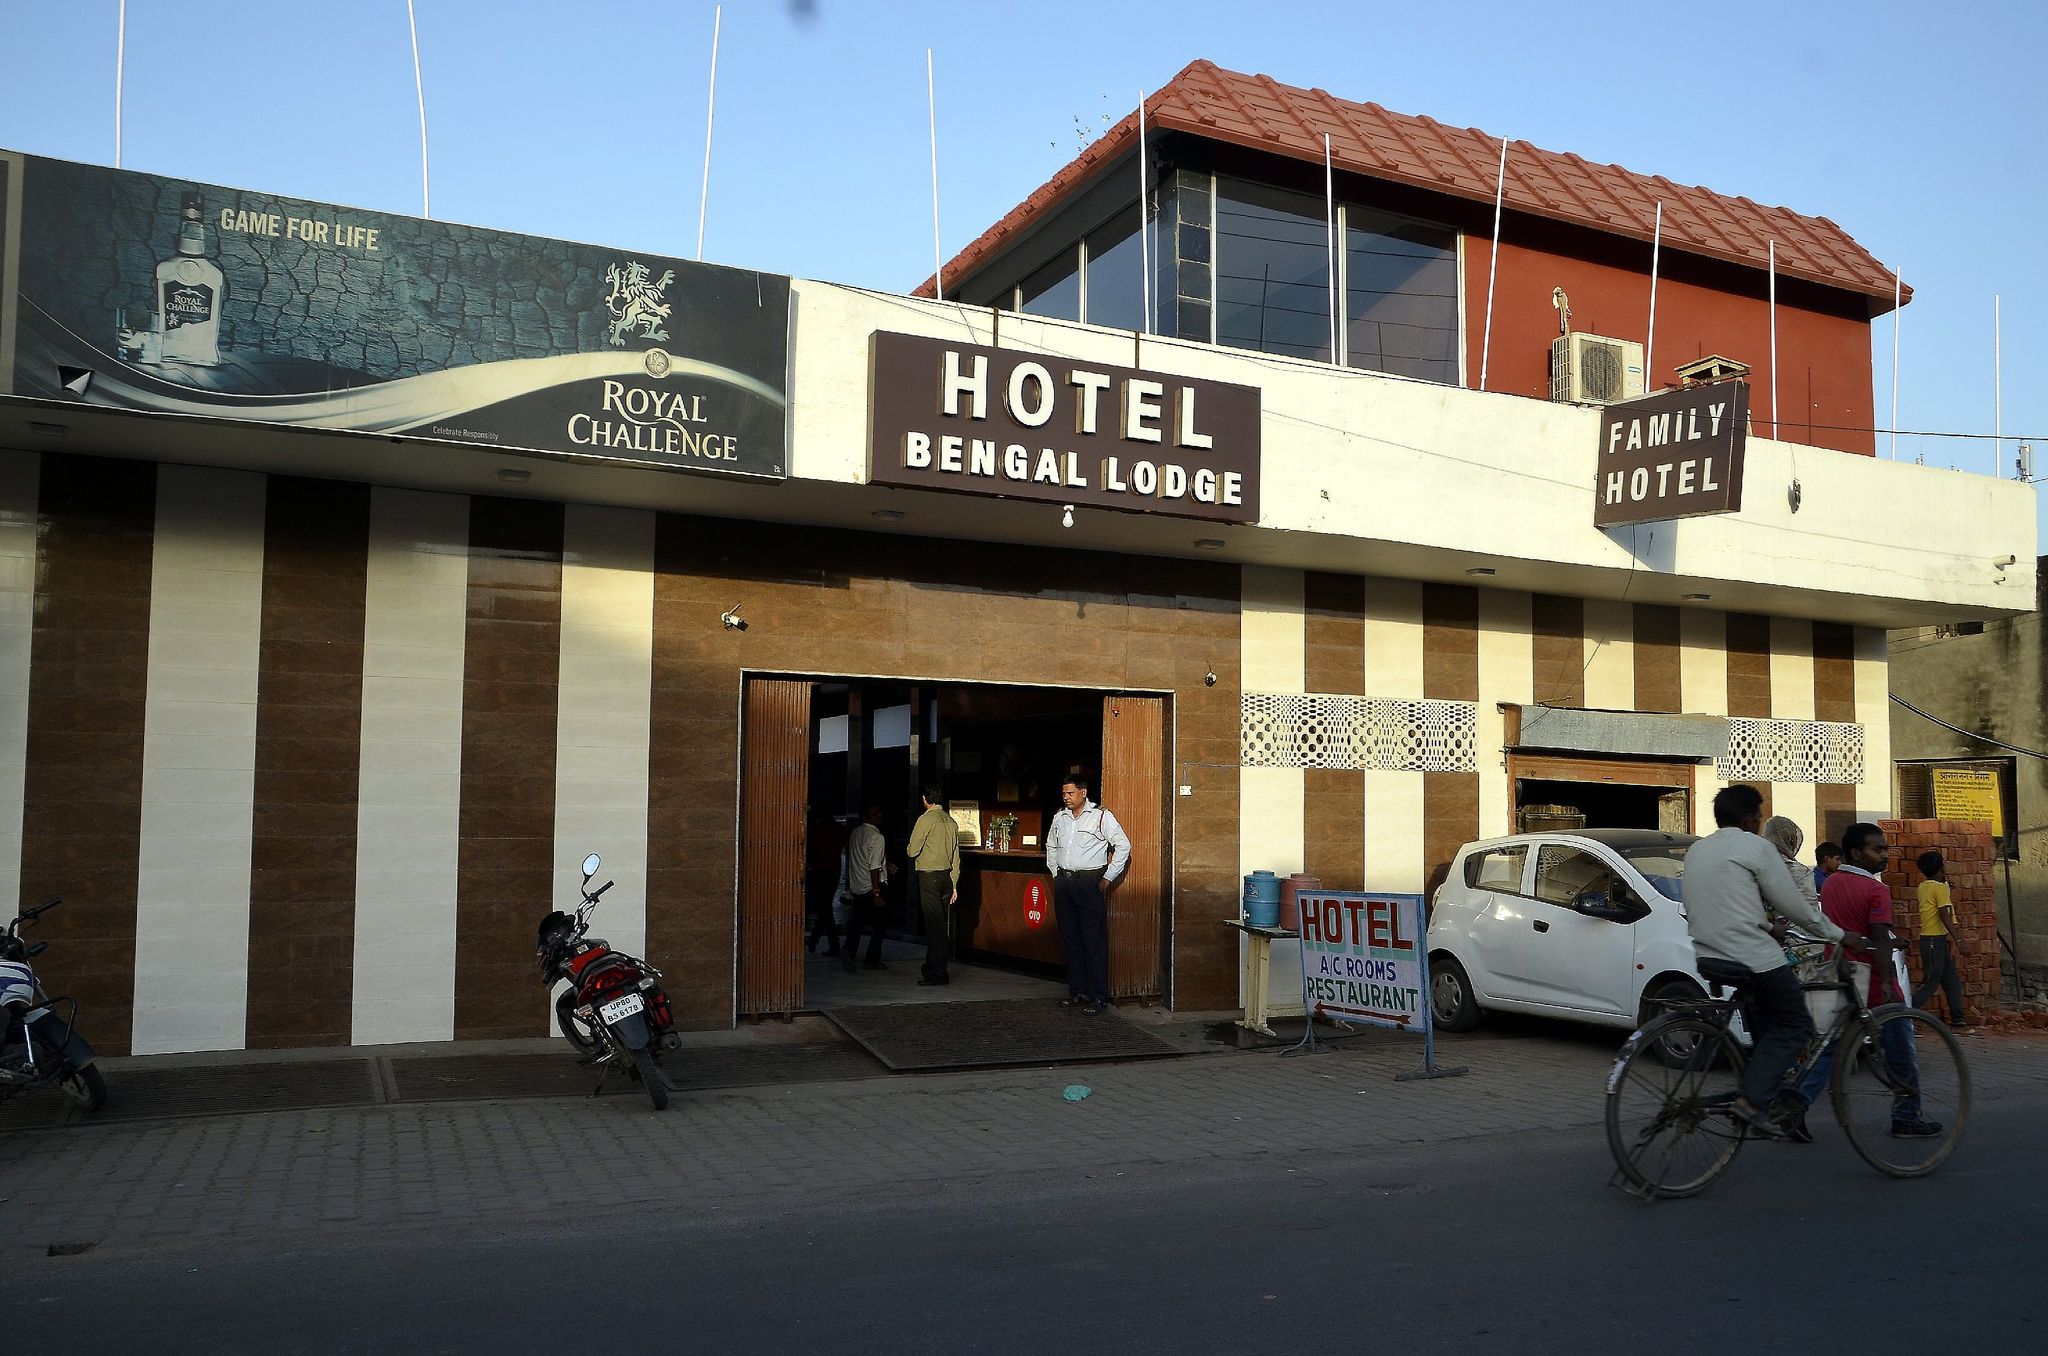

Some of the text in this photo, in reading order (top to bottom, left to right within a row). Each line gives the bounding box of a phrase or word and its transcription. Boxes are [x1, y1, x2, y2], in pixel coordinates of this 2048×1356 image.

[221, 208, 379, 250] GAME FOR LIFE
[166, 302, 210, 314] CHALLENGE
[174, 295, 202, 306] ROYAL
[602, 380, 707, 425] ROYAL
[939, 350, 1213, 448] HOTEL
[432, 426, 462, 437] Celebrate
[567, 413, 738, 461] CHALLENGE
[1608, 402, 1726, 454] FAMILY
[905, 431, 1242, 506] BENGAL LODGE
[1606, 457, 1718, 505] HOTEL
[1300, 898, 1414, 951] HOTEL
[1320, 954, 1397, 981] A/C ROOMS
[610, 998, 630, 1010] UP80
[1307, 977, 1418, 1011] RESTAURANT
